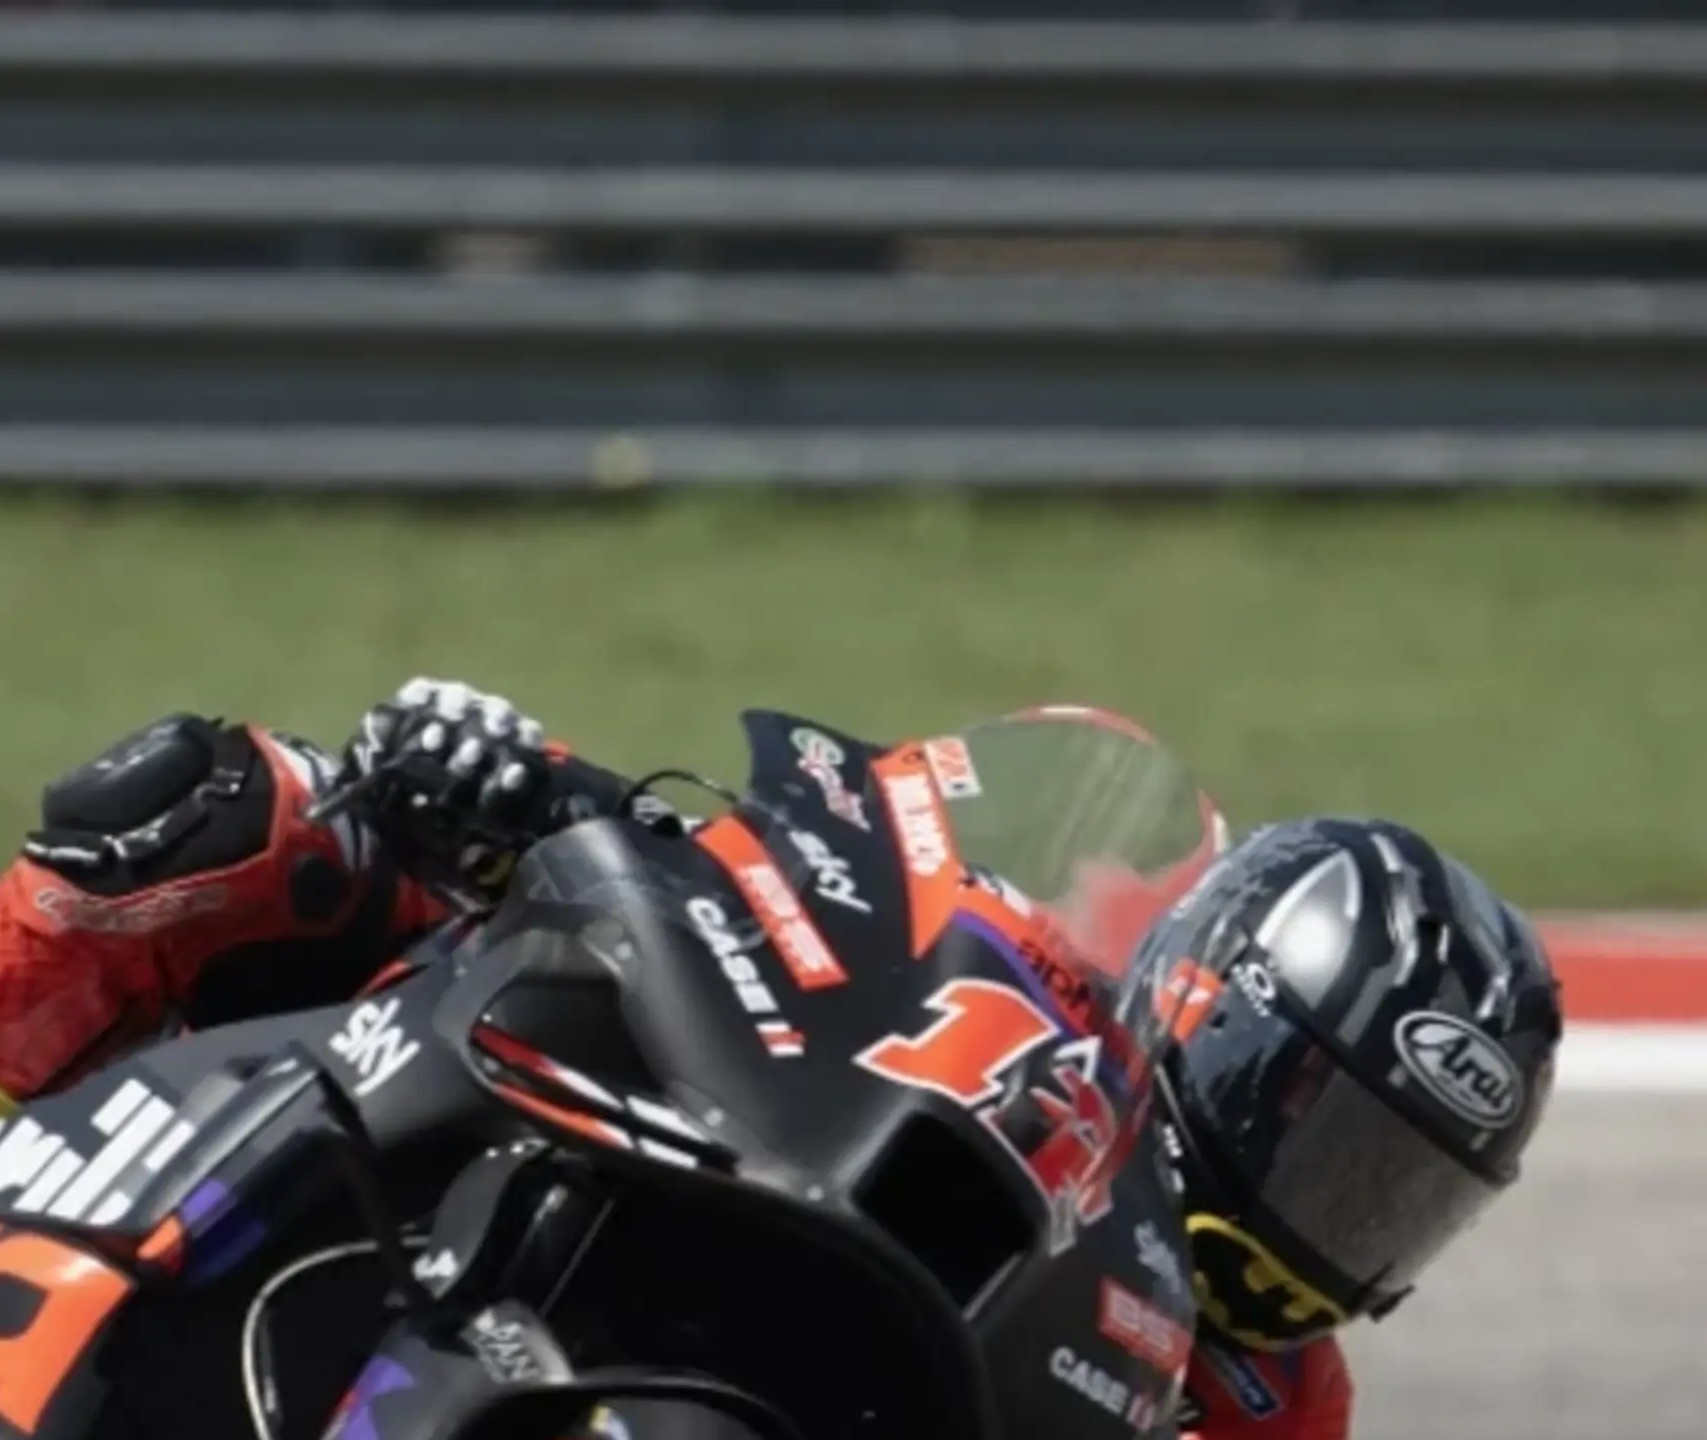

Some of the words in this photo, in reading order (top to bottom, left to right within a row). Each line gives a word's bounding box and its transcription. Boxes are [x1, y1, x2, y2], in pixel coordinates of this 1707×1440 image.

[688, 896, 777, 1013] CASE
[328, 998, 420, 1097] sky
[1048, 1347, 1128, 1413] CASE
